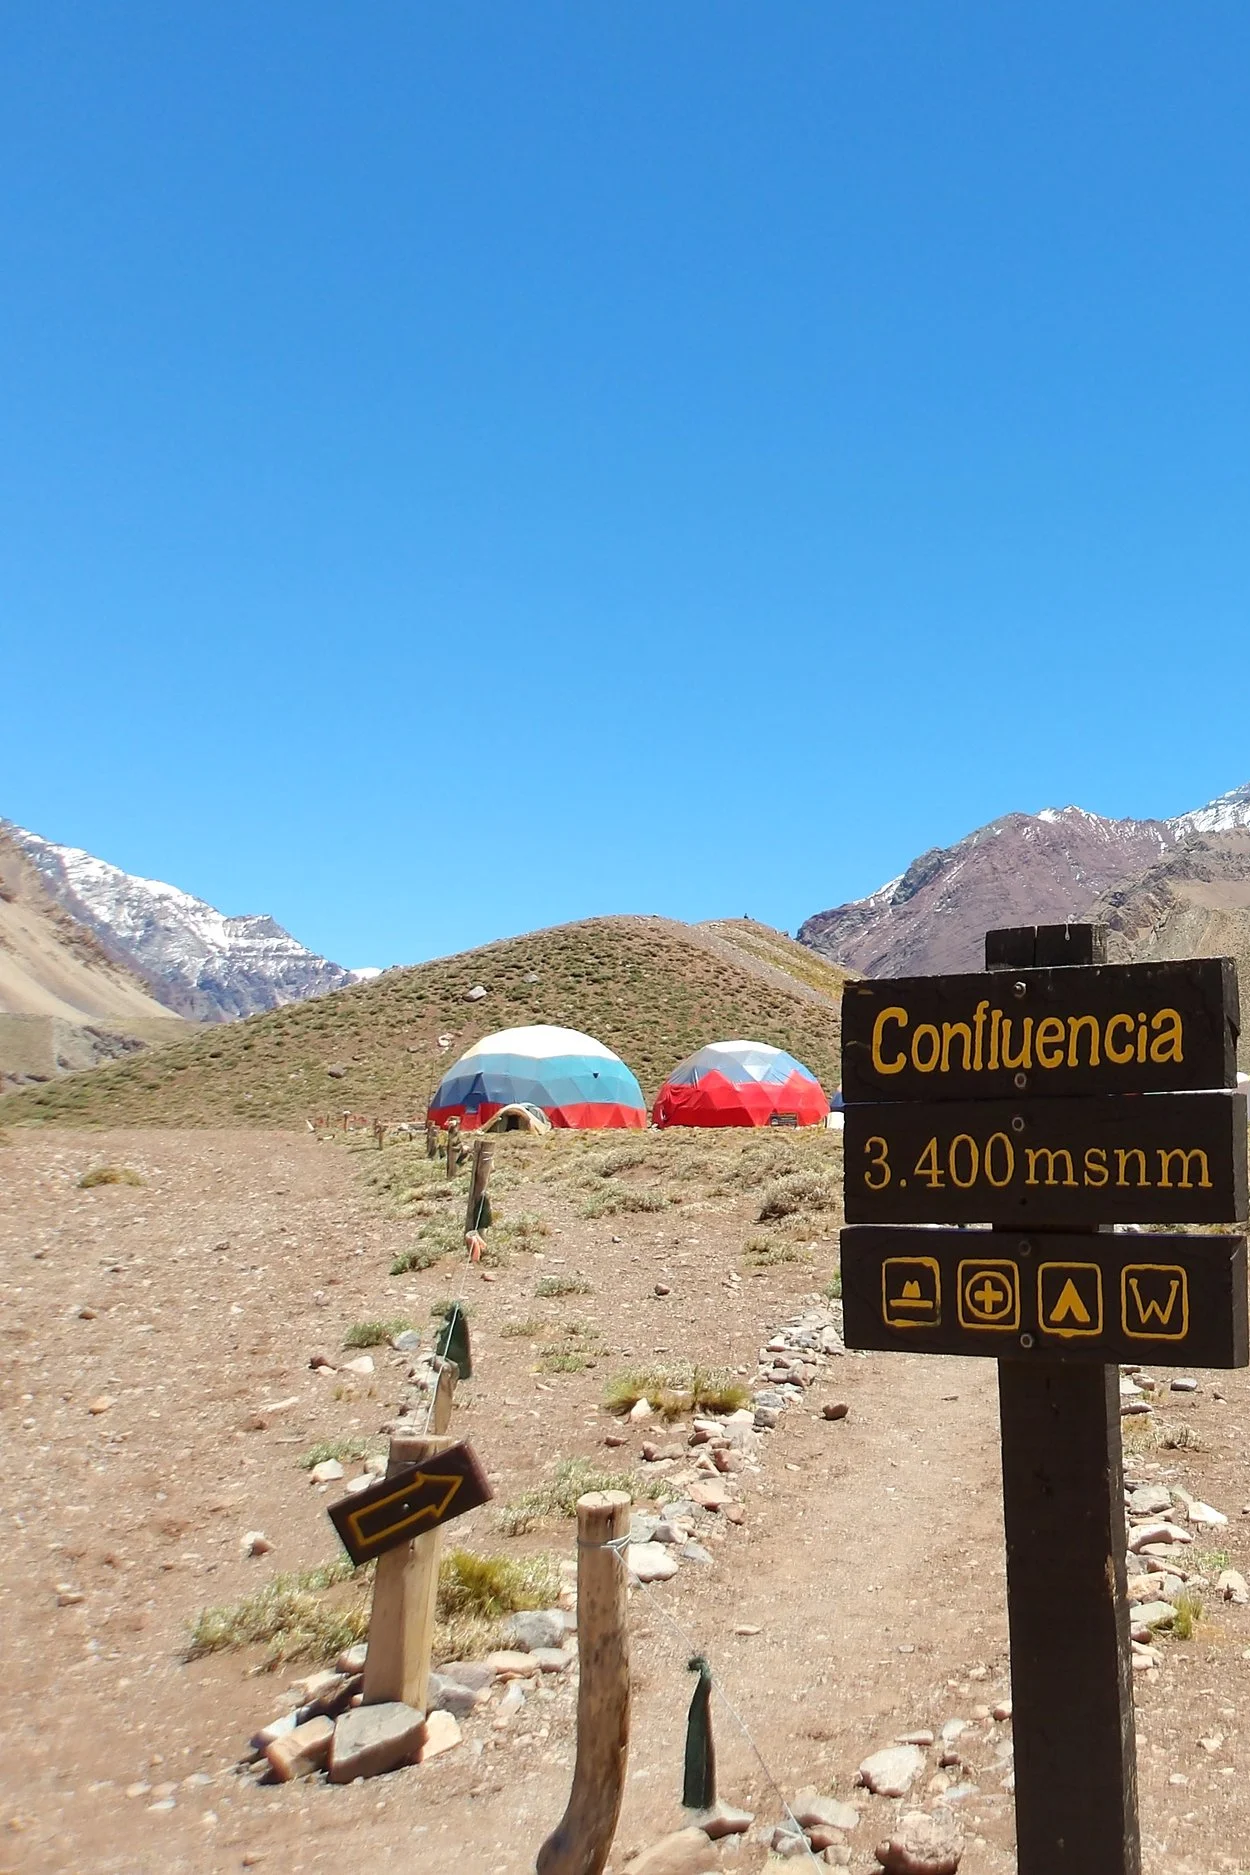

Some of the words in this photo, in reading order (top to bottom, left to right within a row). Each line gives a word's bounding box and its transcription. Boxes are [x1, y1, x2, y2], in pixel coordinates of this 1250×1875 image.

[871, 1000, 1184, 1075] Confluencia
[863, 1131, 1015, 1191] 3.400
[1024, 1146, 1213, 1188] msnm
[1129, 1276, 1180, 1326] W
